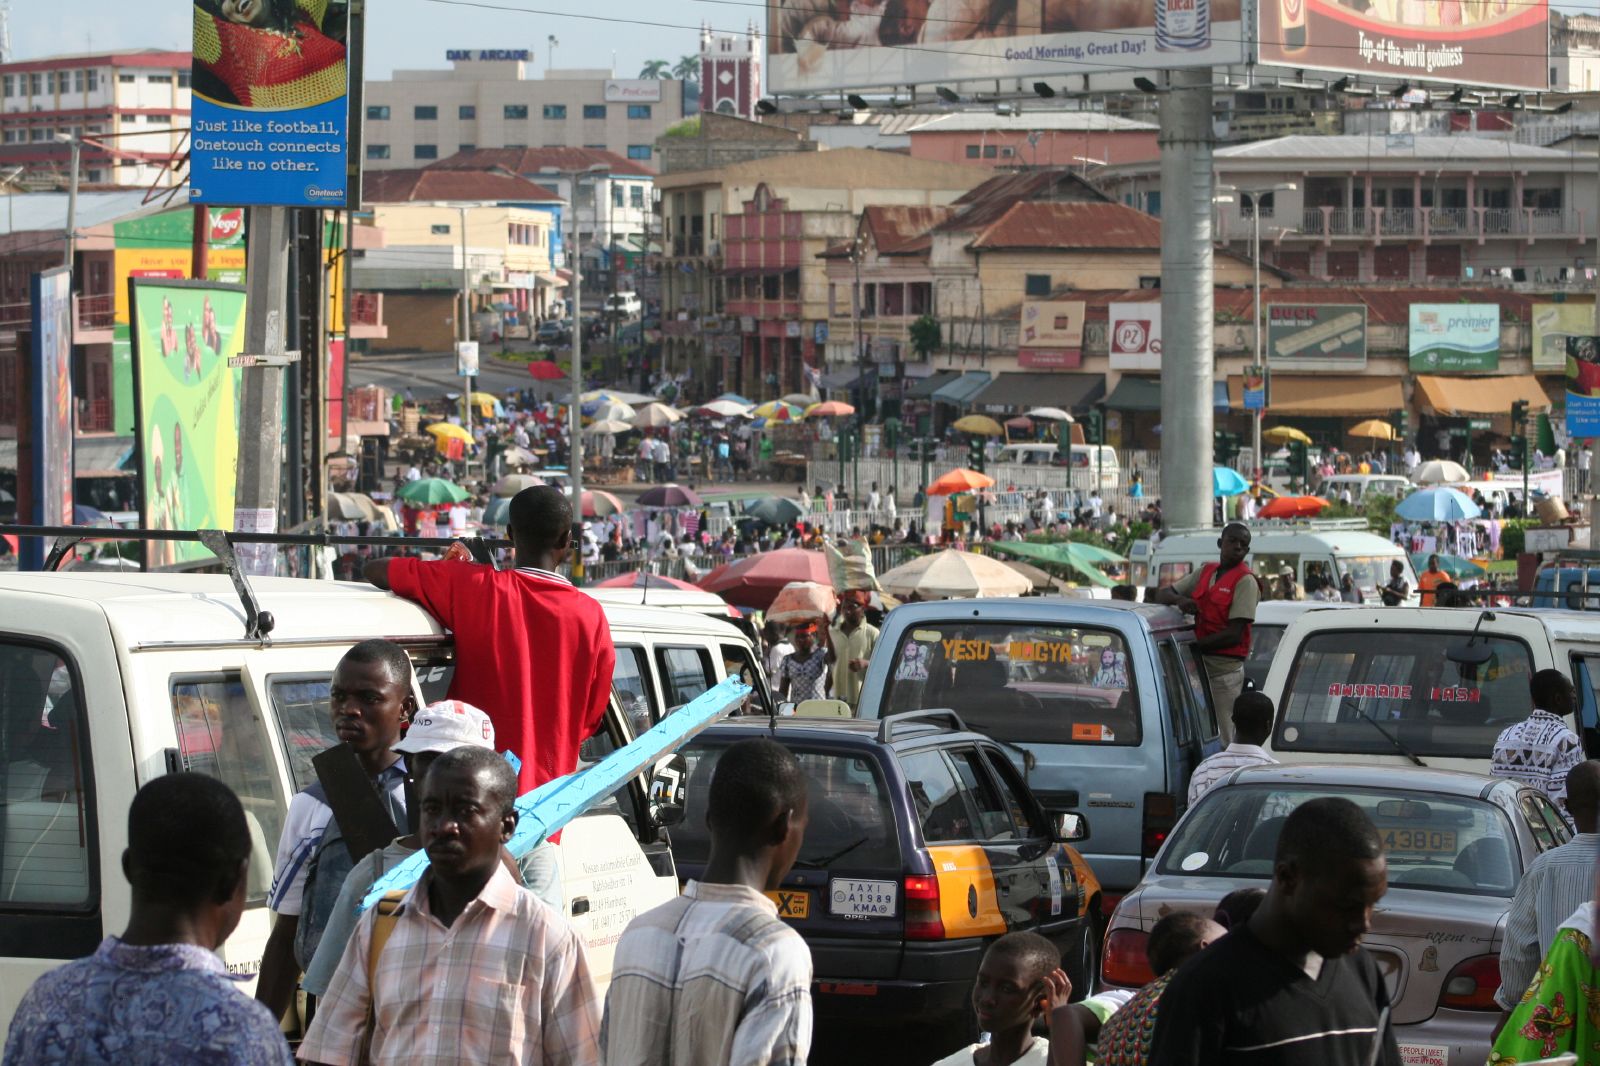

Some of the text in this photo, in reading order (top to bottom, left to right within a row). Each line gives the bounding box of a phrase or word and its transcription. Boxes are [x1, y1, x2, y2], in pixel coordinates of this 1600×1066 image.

[446, 49, 529, 61] DAK ARCADE
[1005, 39, 1147, 61] Good Morning, Great Day!
[1358, 30, 1463, 72] Top-of-the-world goodness
[195, 120, 340, 136] Just like football,
[194, 139, 341, 153] Onetouch connects
[212, 157, 320, 172] like no other.
[1447, 313, 1495, 332] premier
[1123, 329, 1138, 344] PZ
[942, 639, 992, 661] YESU
[849, 883, 880, 893] TAXI
[849, 894, 891, 903] A1989
[854, 904, 877, 912] KMA
[1404, 1047, 1425, 1055] PEOPLE
[1428, 1049, 1445, 1058] MEET,
